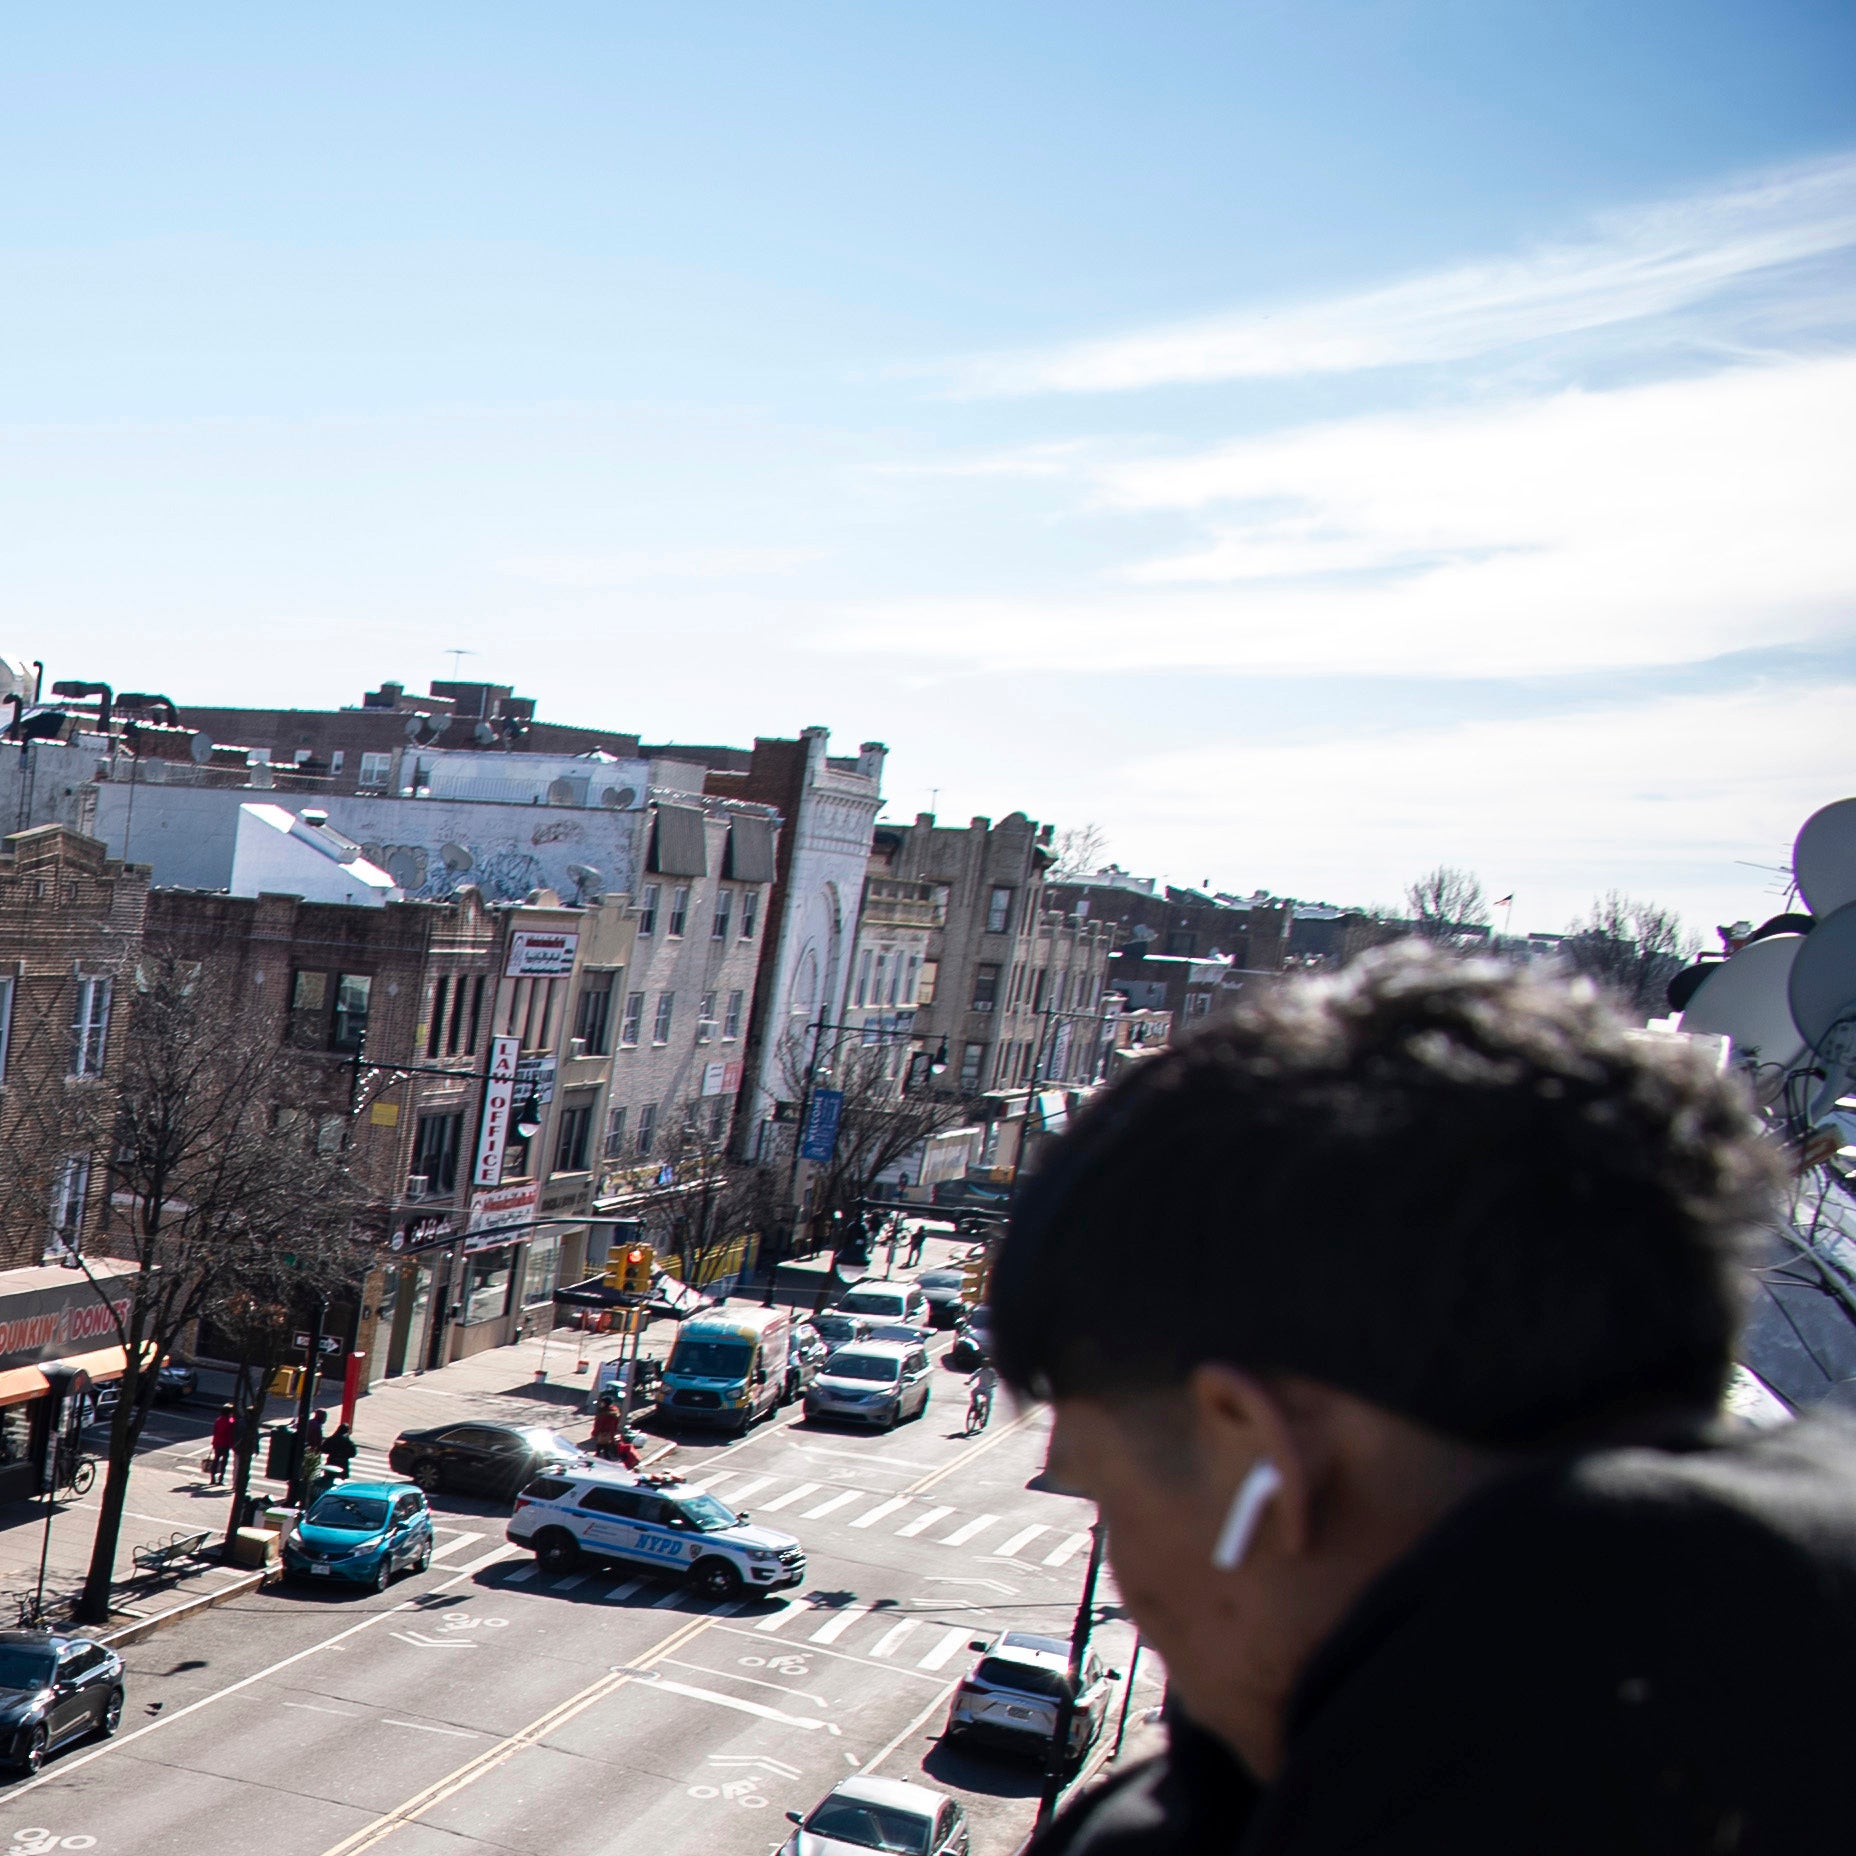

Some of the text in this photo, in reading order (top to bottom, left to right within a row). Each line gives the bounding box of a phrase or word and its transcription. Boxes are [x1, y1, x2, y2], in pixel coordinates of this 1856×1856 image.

[480, 1042, 514, 1182] LAW OFFICE
[634, 1532, 684, 1557] NYPD
